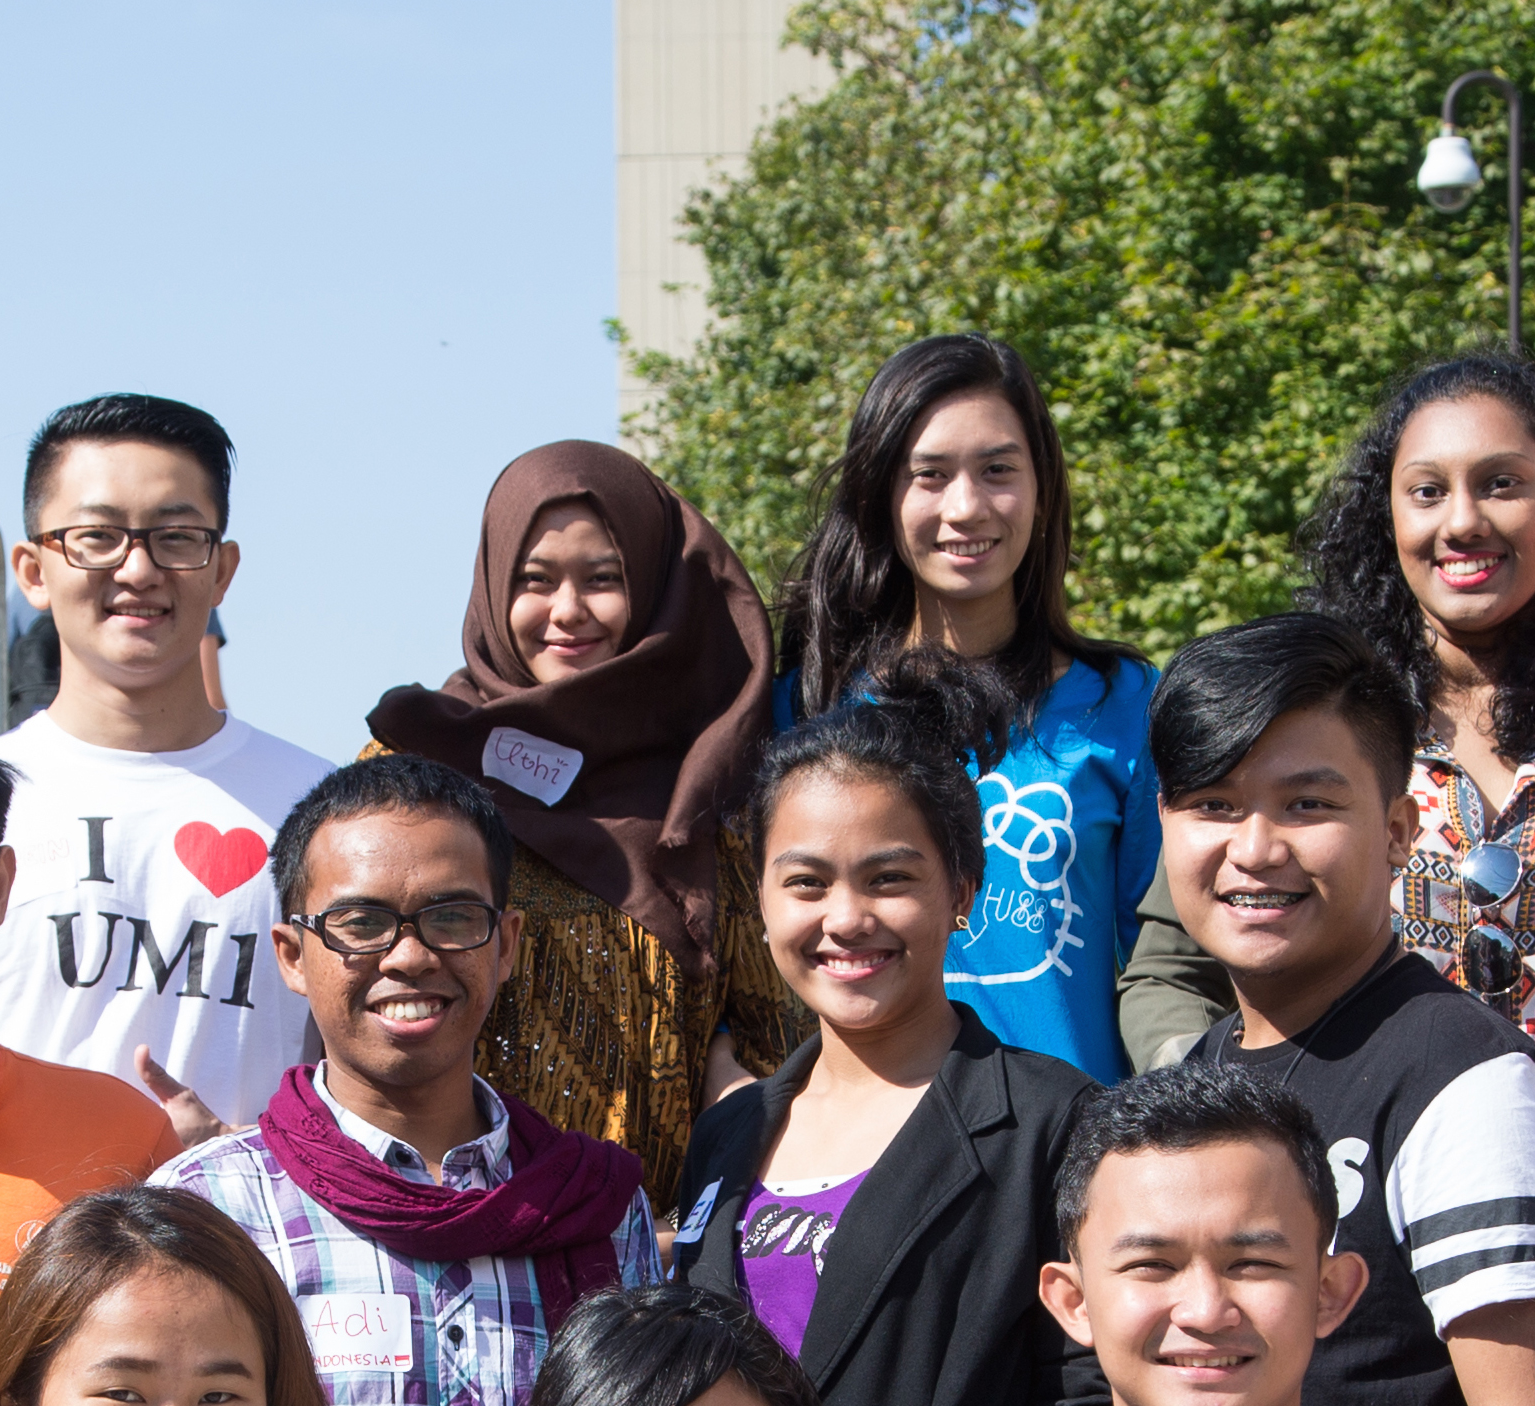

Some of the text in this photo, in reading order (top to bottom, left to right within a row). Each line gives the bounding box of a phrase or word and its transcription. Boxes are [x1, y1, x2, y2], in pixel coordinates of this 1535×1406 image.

[78, 816, 115, 884] I
[311, 1300, 388, 1337] Adi
[315, 1353, 391, 1368] NDONESIA
